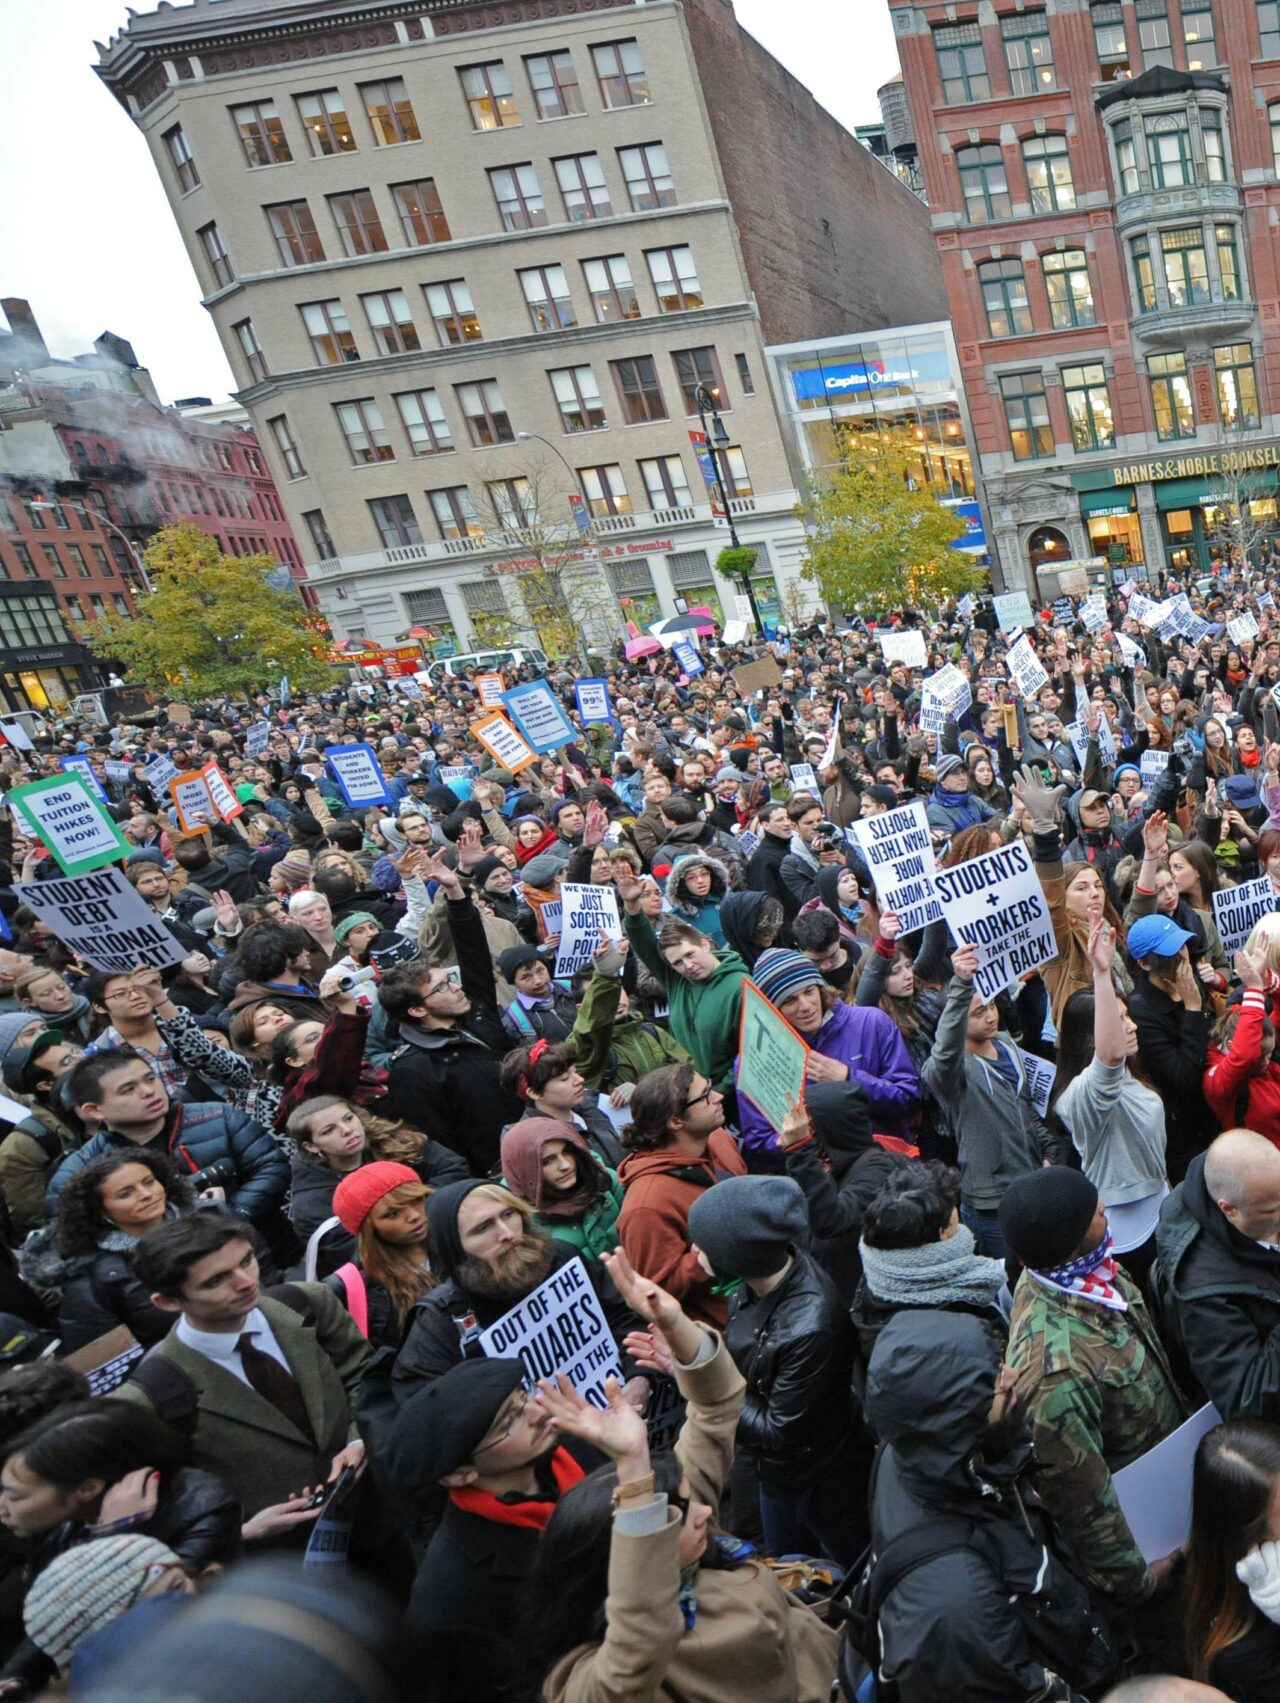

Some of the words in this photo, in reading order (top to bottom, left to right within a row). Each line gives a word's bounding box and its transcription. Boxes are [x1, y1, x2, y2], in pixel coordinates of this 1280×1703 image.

[826, 376, 868, 388] Capital
[1113, 454, 1218, 485] BARNES&NOBLE
[627, 540, 673, 554] Grooming
[582, 695, 603, 705] 99%
[491, 732, 513, 747] WORKERS
[333, 752, 366, 762] STUDENTS
[341, 766, 372, 775] WORKERS
[1142, 752, 1160, 762] LIVING
[44, 792, 72, 807] END
[183, 790, 203, 801] MORE
[40, 801, 90, 823] TUITION
[54, 814, 94, 834] HIKES
[869, 809, 917, 840] PROFITS
[64, 827, 100, 845] NOW!
[899, 828, 930, 854] THAN
[868, 836, 898, 864] THEIR
[892, 854, 924, 882] MORE
[934, 846, 1029, 903] STUDENTS
[21, 872, 122, 907] STUDENT
[580, 894, 603, 911] JUST
[581, 886, 605, 894] WANT
[885, 881, 925, 910] WORTH
[1216, 889, 1236, 908] OUT
[1239, 885, 1252, 900] OF
[1252, 879, 1270, 896] THE
[60, 898, 118, 926] DEBT
[570, 912, 616, 929] SOCIETY!
[898, 906, 924, 933] LIVES
[958, 895, 1042, 946] WORKERS
[1218, 897, 1274, 937] SQUARES
[64, 924, 169, 955] NATIONAL
[90, 924, 104, 933] IS
[104, 923, 113, 932] A
[985, 938, 1012, 958] TAKE
[1012, 928, 1032, 948] THE
[1223, 937, 1240, 951] AND
[975, 961, 1010, 998] CITY
[1012, 932, 1053, 974] BACK!
[1032, 1071, 1052, 1108] PROFITS
[490, 1308, 526, 1354] OUT
[527, 1293, 550, 1326] OF
[549, 1264, 586, 1305] THE
[517, 1293, 603, 1382] QUARES
[586, 1338, 614, 1372] THE
